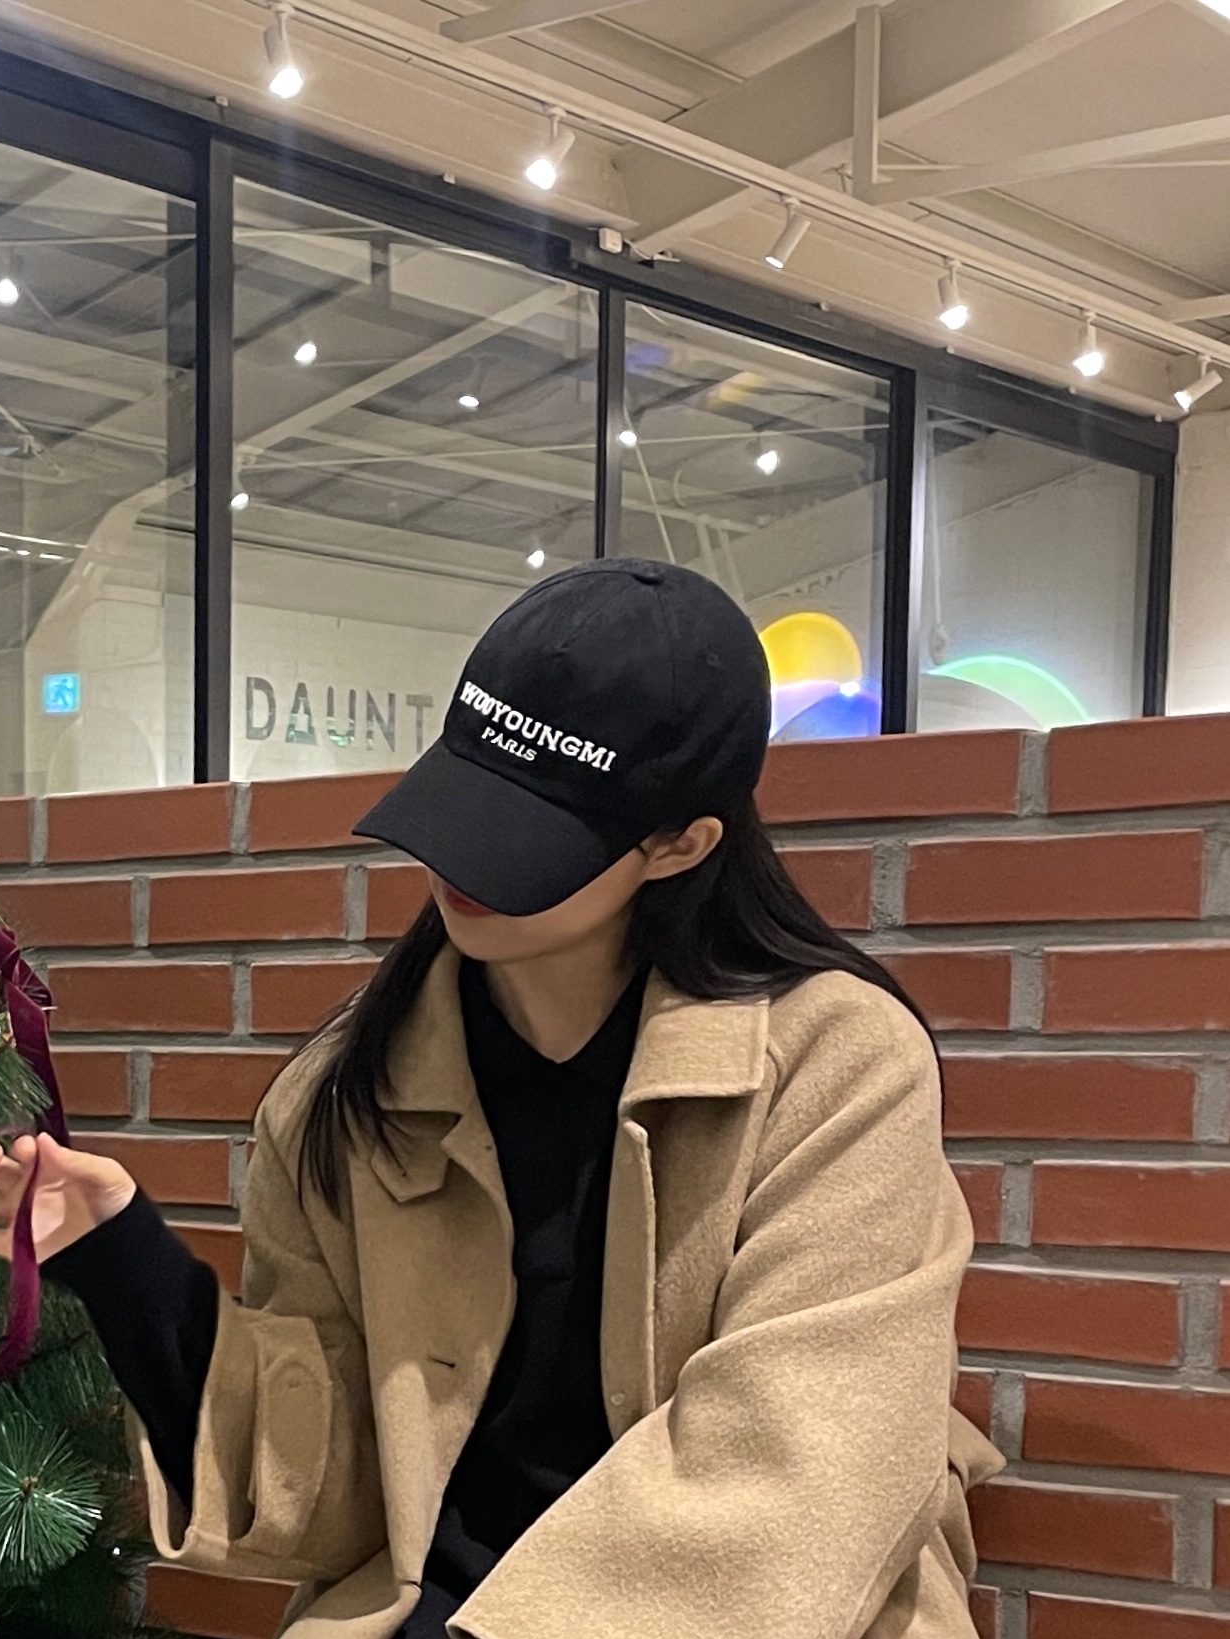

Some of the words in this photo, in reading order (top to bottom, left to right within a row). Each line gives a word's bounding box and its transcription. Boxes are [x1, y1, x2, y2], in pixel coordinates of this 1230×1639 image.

[245, 676, 434, 754] DAUNT
[459, 680, 617, 772] WOOYOUNGMI
[481, 726, 538, 762] PARIS
